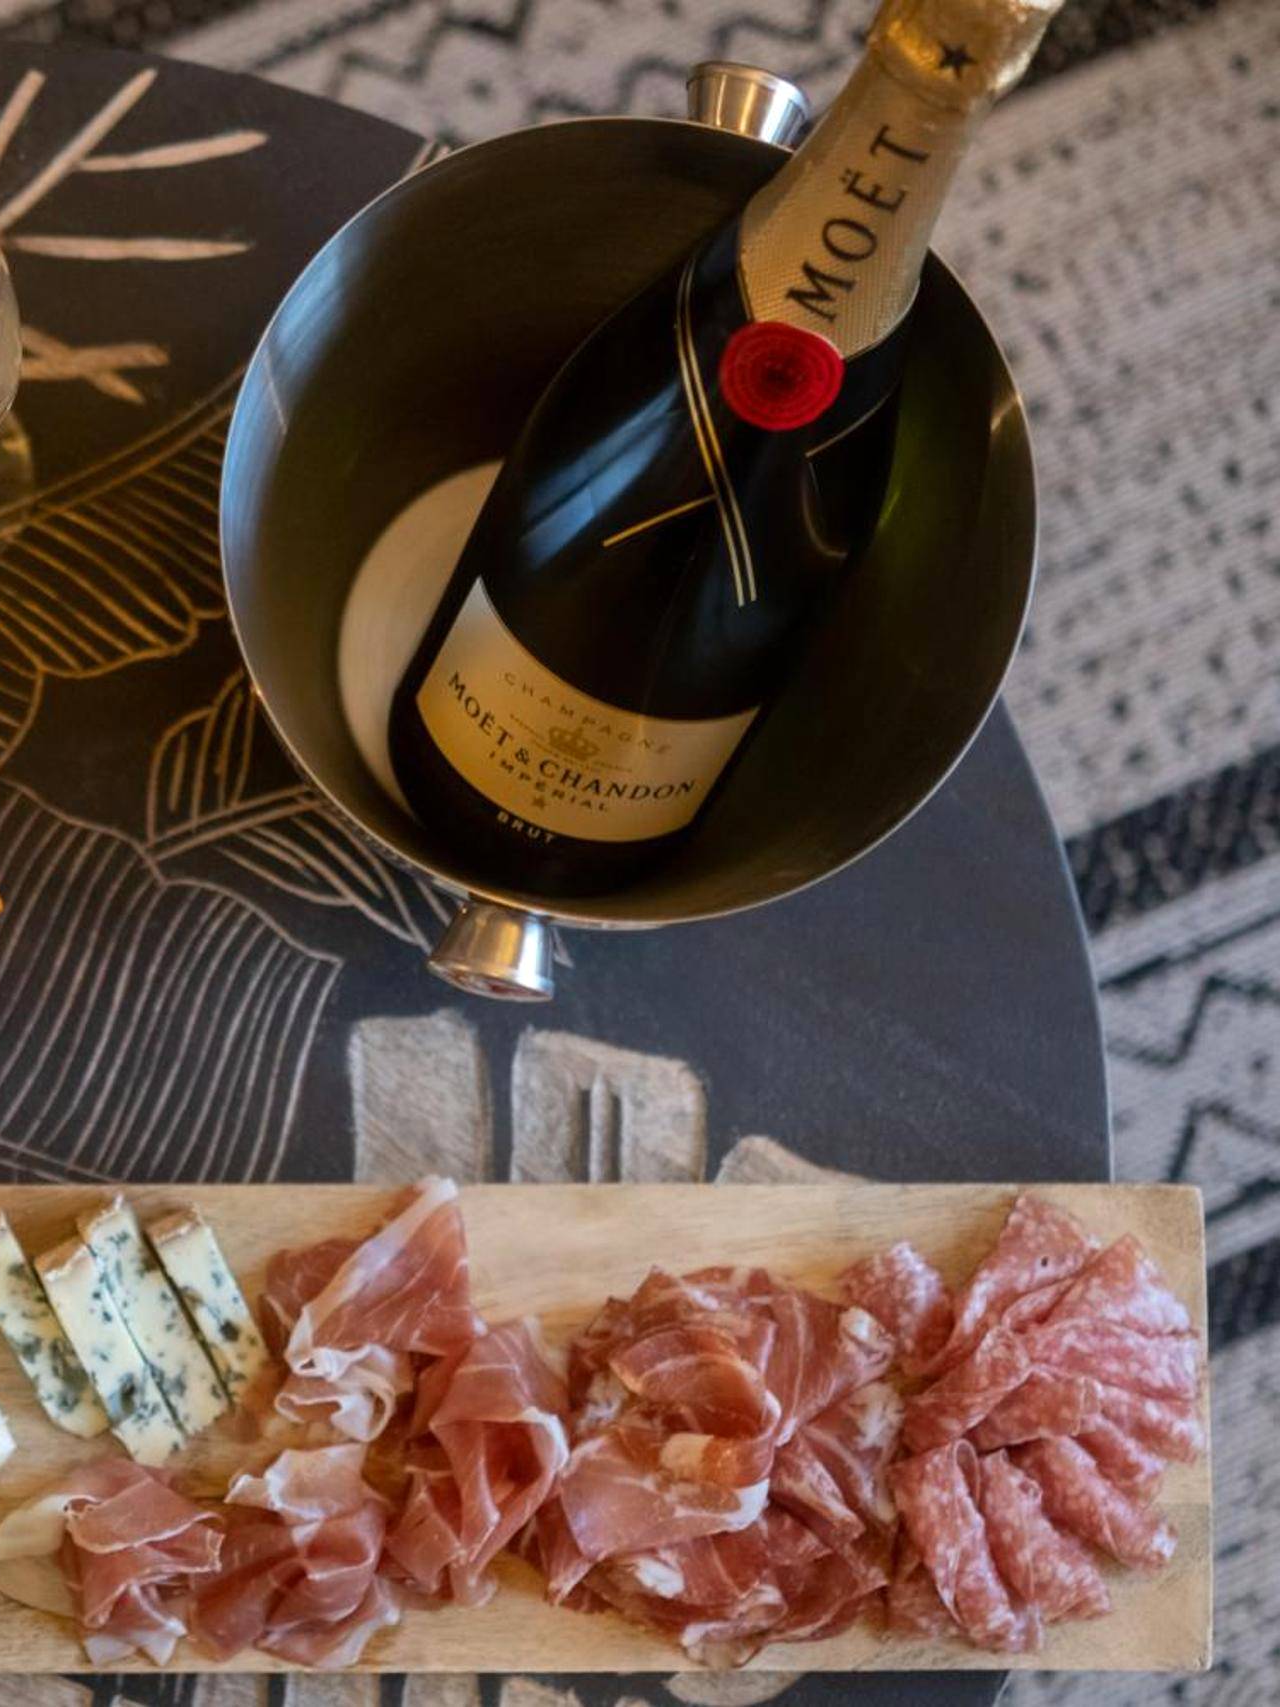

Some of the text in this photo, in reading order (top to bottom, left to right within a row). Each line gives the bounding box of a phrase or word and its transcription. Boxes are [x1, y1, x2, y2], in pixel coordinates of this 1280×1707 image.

[785, 122, 931, 324] MOËT
[448, 670, 697, 802] MOËT & CHANDON
[504, 671, 672, 755] CHAMPAGNE
[496, 810, 557, 845] BRUT
